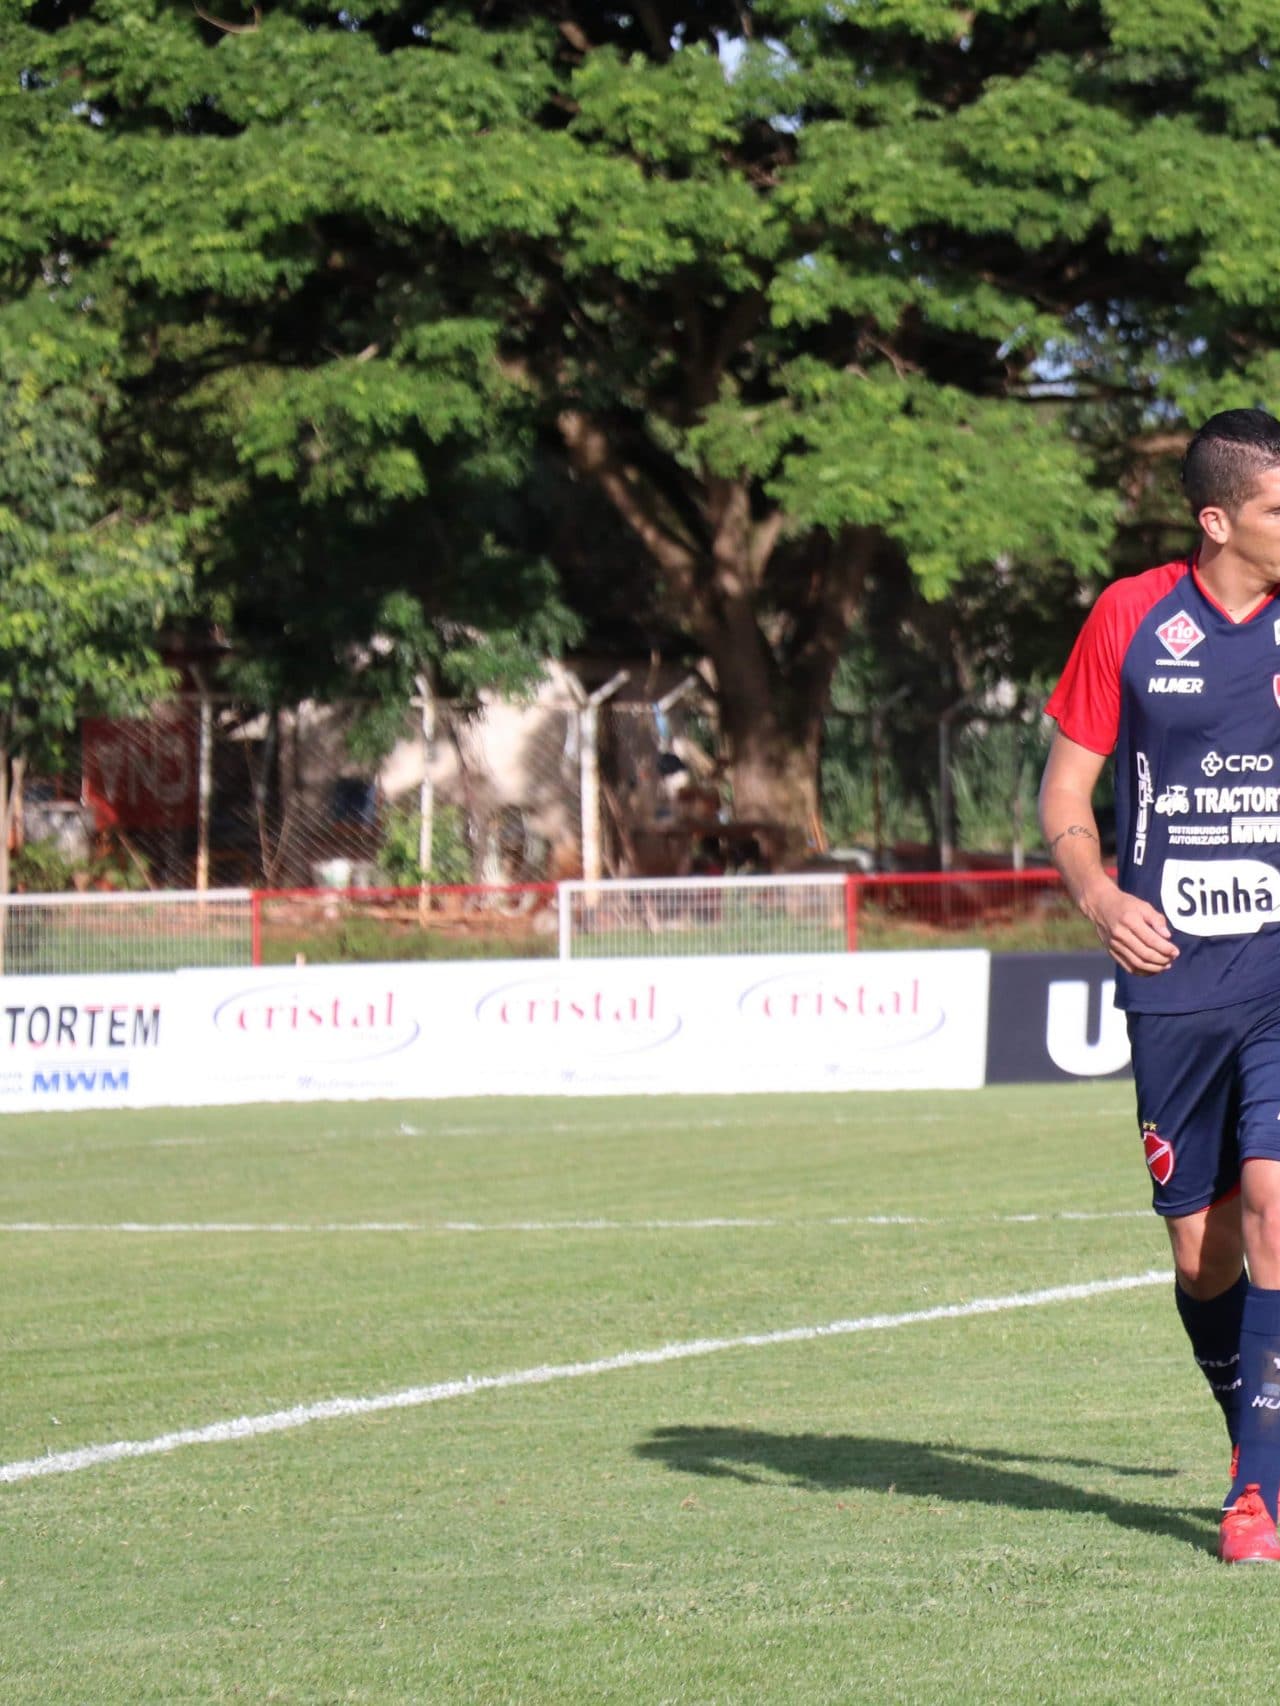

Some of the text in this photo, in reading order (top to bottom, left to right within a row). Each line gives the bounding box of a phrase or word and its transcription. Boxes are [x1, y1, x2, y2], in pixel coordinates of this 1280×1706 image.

[1148, 677, 1204, 693] NUMER
[1225, 754, 1273, 772] CRD
[1168, 835, 1229, 845] AUTORIZADO
[1177, 875, 1273, 917] Sinhá
[237, 991, 394, 1030] cristal
[500, 985, 655, 1023] cristal
[763, 978, 919, 1017] cristal
[5, 1003, 161, 1048] TORTEM
[32, 1070, 129, 1094] MWM
